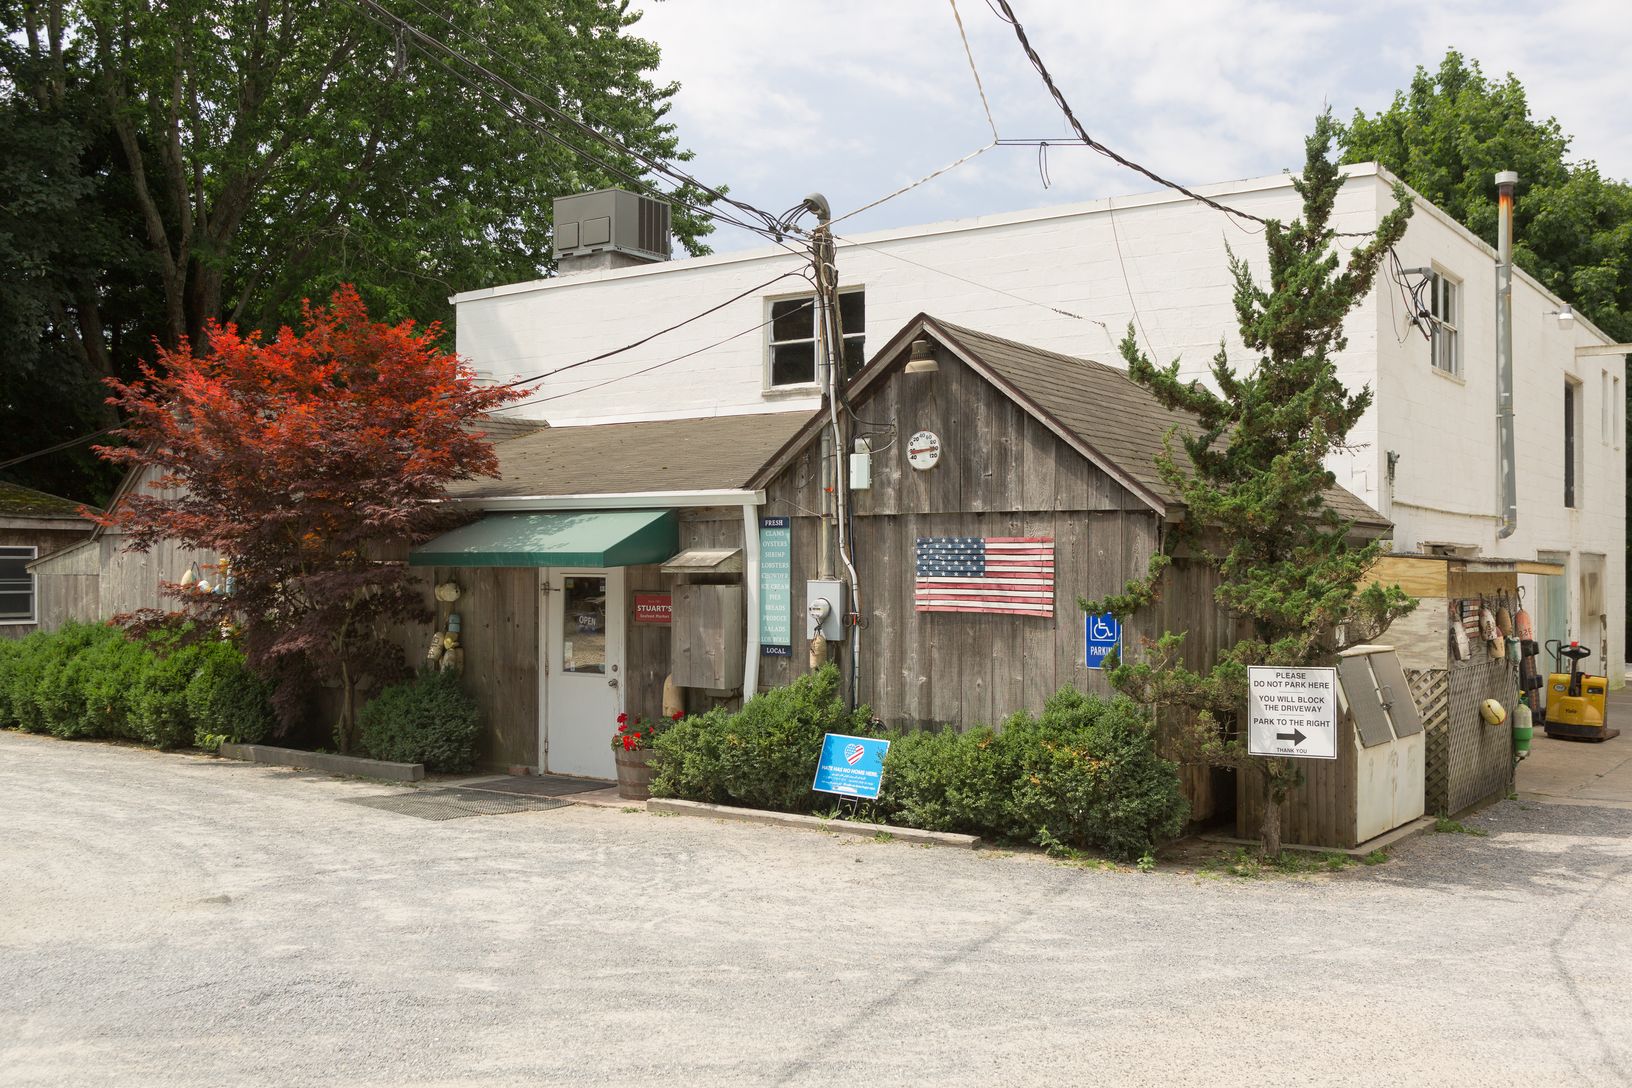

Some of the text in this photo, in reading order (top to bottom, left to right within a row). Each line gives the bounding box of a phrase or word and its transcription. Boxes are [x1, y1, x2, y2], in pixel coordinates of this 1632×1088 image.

[637, 604, 672, 613] STUART'S
[578, 615, 596, 626] OPEN
[1253, 680, 1265, 688] DO
[1297, 696, 1325, 704] BLOCK
[1280, 705, 1322, 713] DRIVEWAY
[1253, 717, 1275, 725] PARK
[1277, 718, 1288, 726] TO
